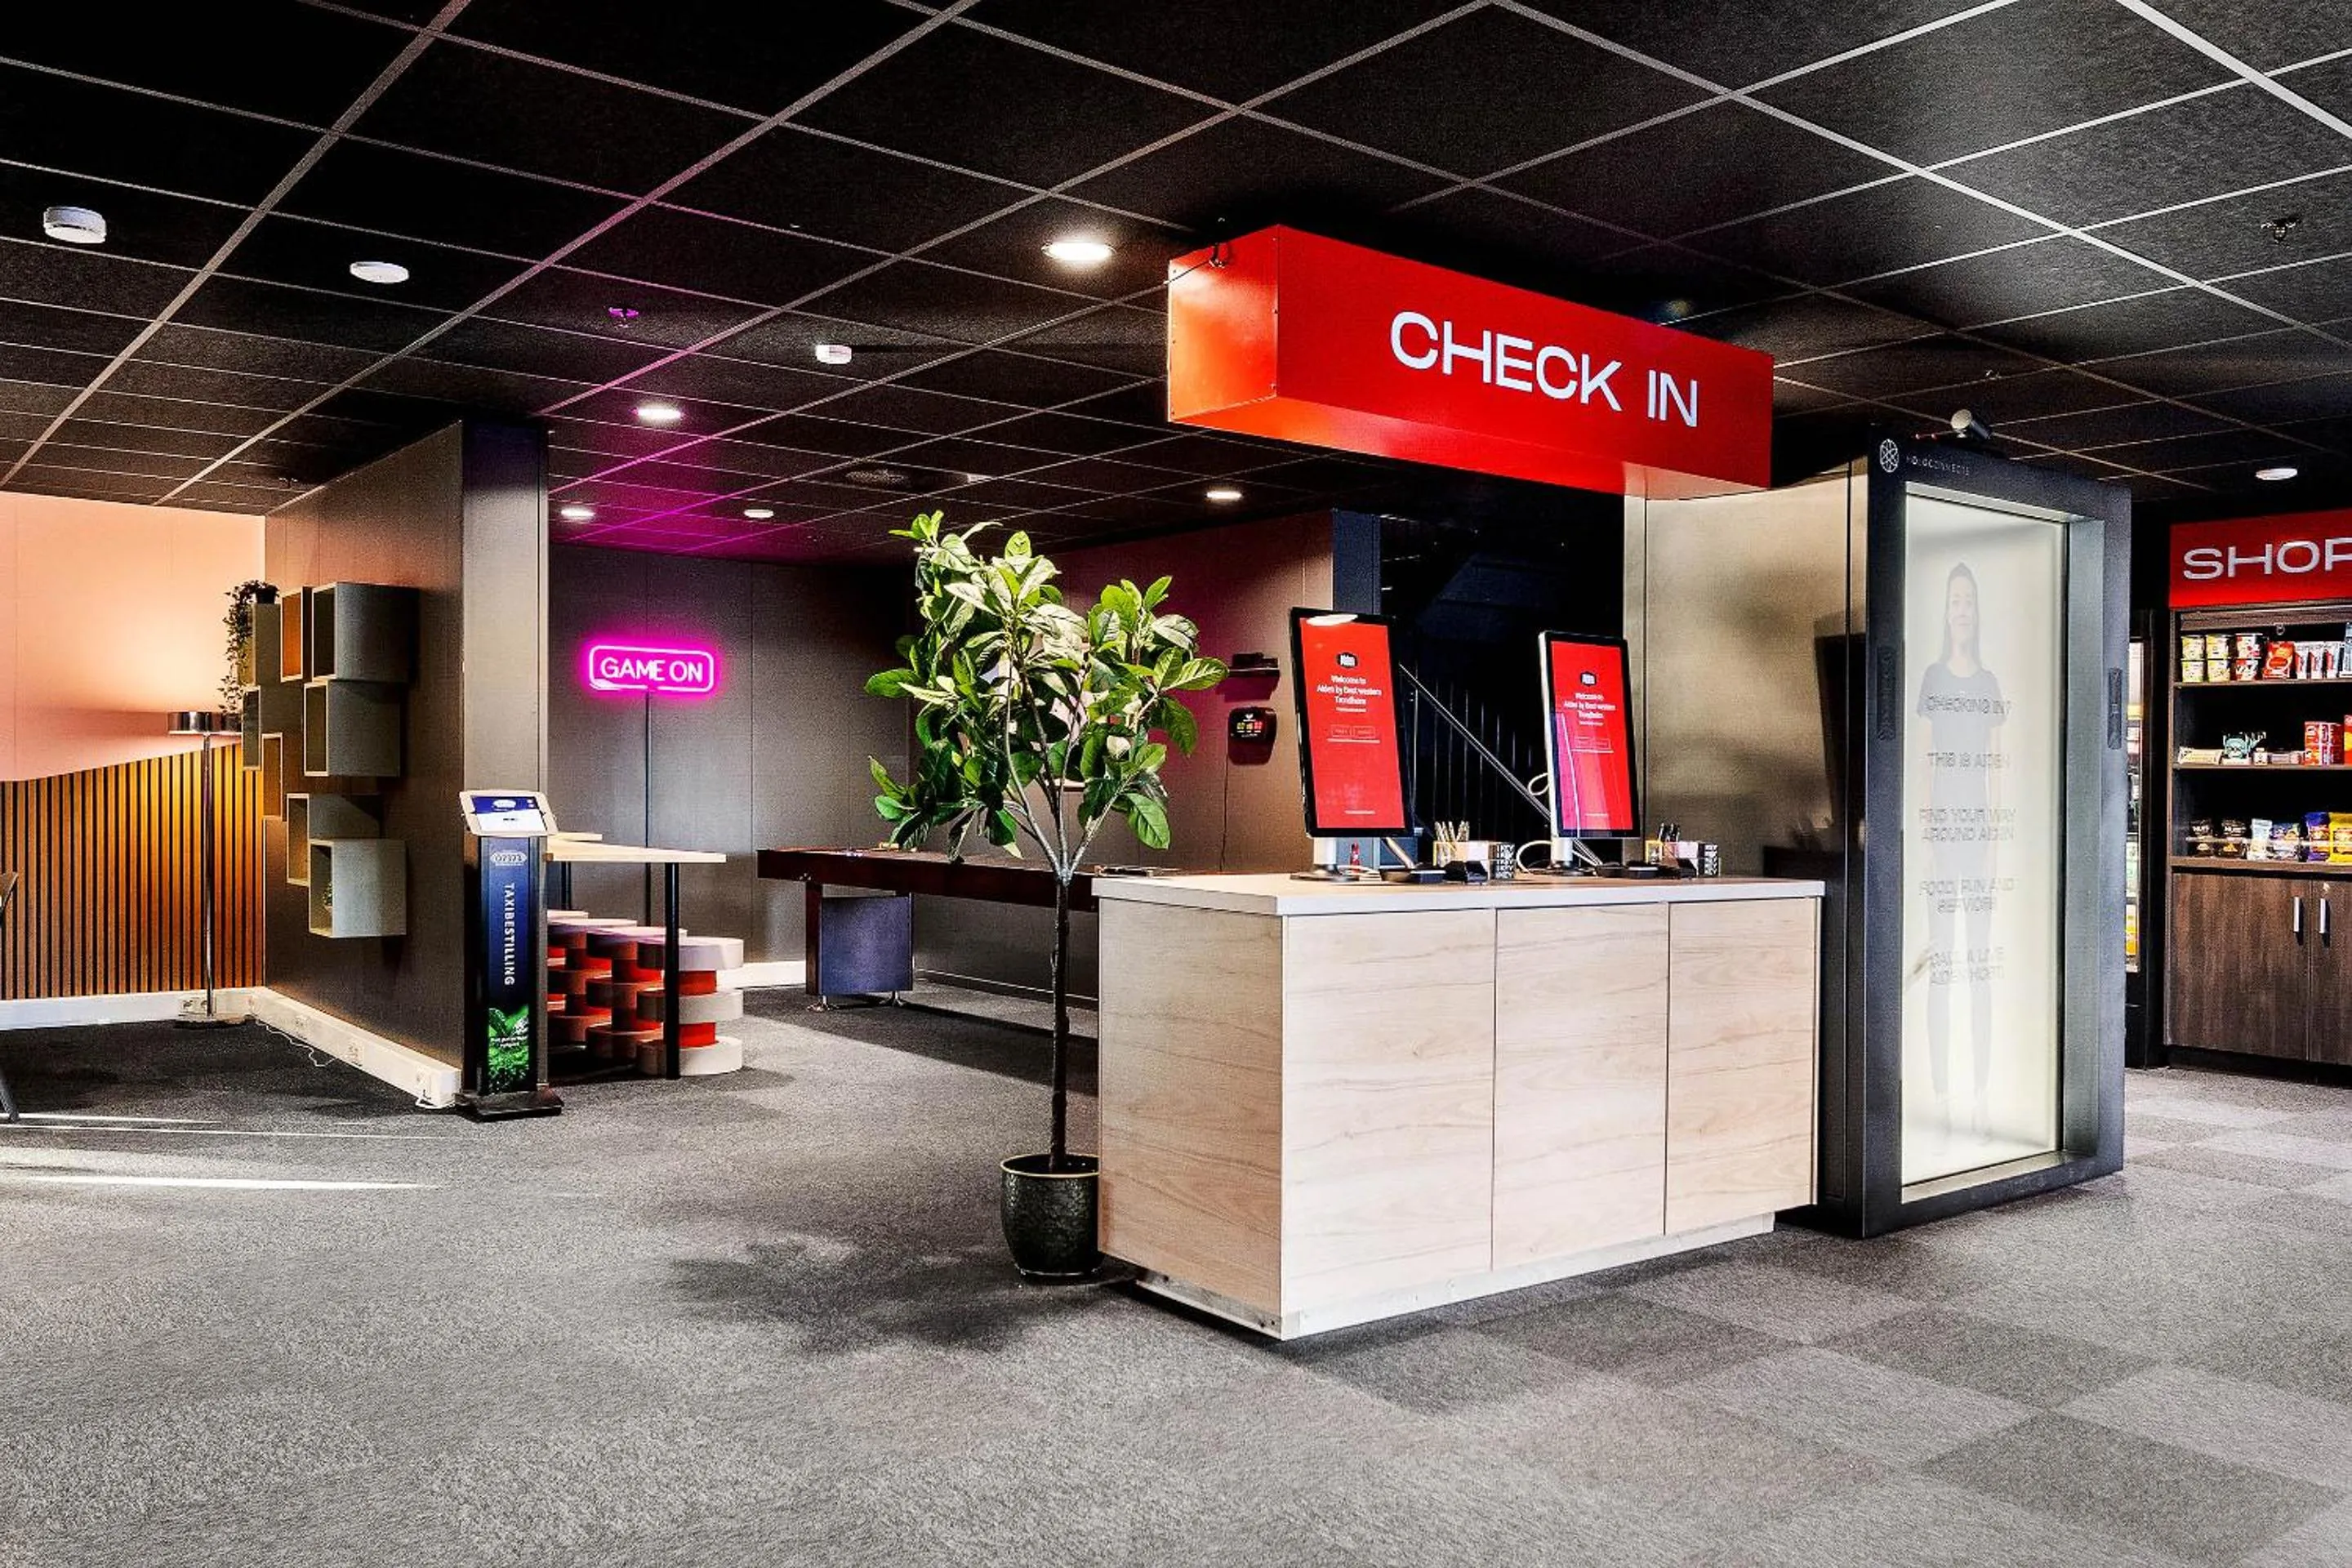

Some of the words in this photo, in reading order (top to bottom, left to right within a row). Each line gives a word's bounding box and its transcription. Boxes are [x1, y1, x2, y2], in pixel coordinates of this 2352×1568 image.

[1389, 310, 1624, 412] CHECK
[1646, 369, 1699, 429] IN
[2182, 537, 2352, 581] SHOP
[600, 657, 666, 682] GAME
[669, 660, 704, 683] ON
[1927, 694, 1990, 714] CHECKING
[1927, 751, 1956, 768] THIS
[1950, 808, 1985, 823] YOUR
[504, 882, 515, 986] TAXIBESTILLING
